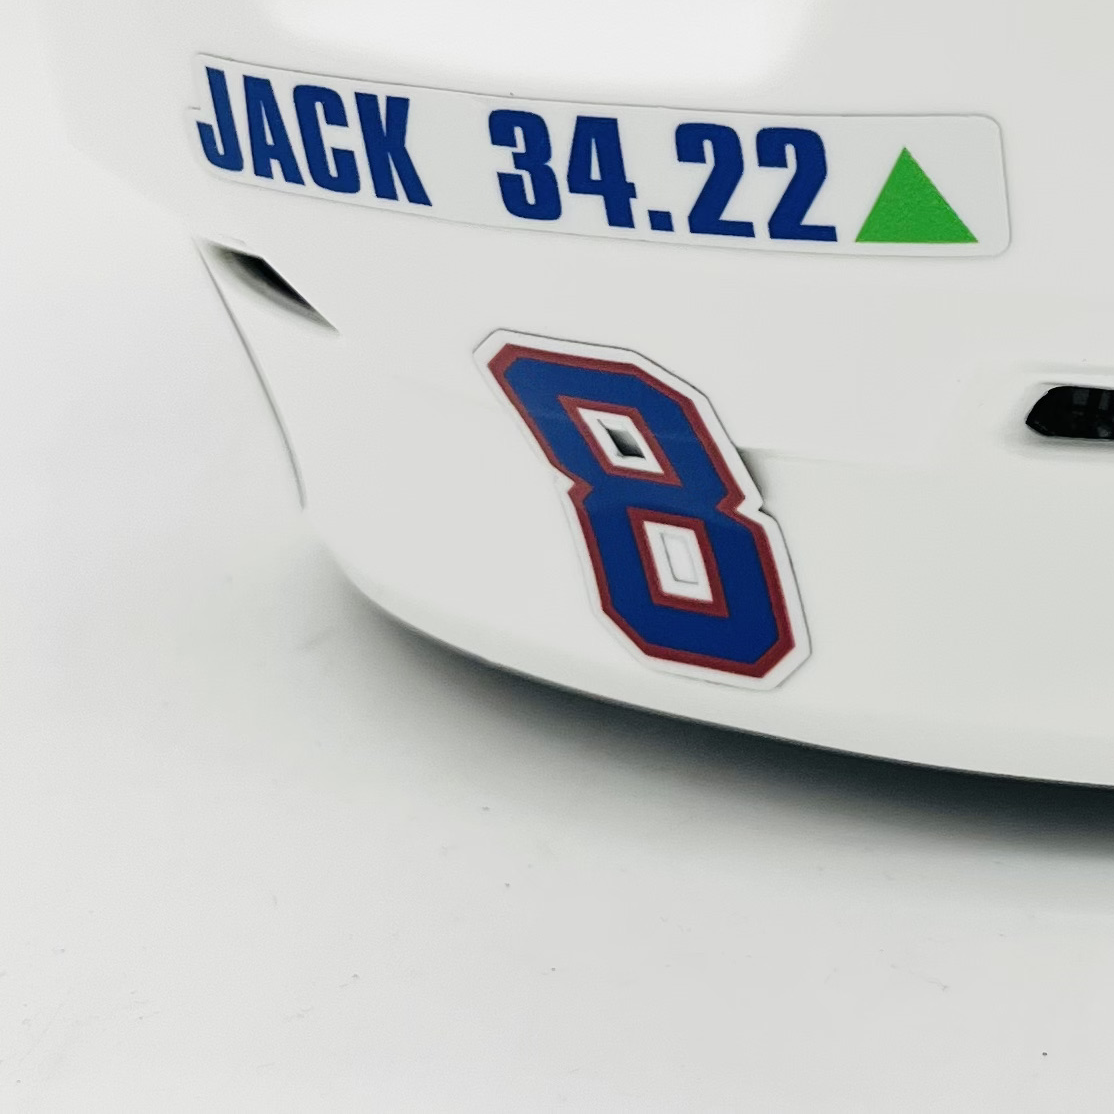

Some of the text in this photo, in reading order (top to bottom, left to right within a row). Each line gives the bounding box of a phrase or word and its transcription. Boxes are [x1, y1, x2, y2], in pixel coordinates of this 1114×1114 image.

[196, 66, 838, 243] JACK 34.22
[488, 343, 796, 679] 8
